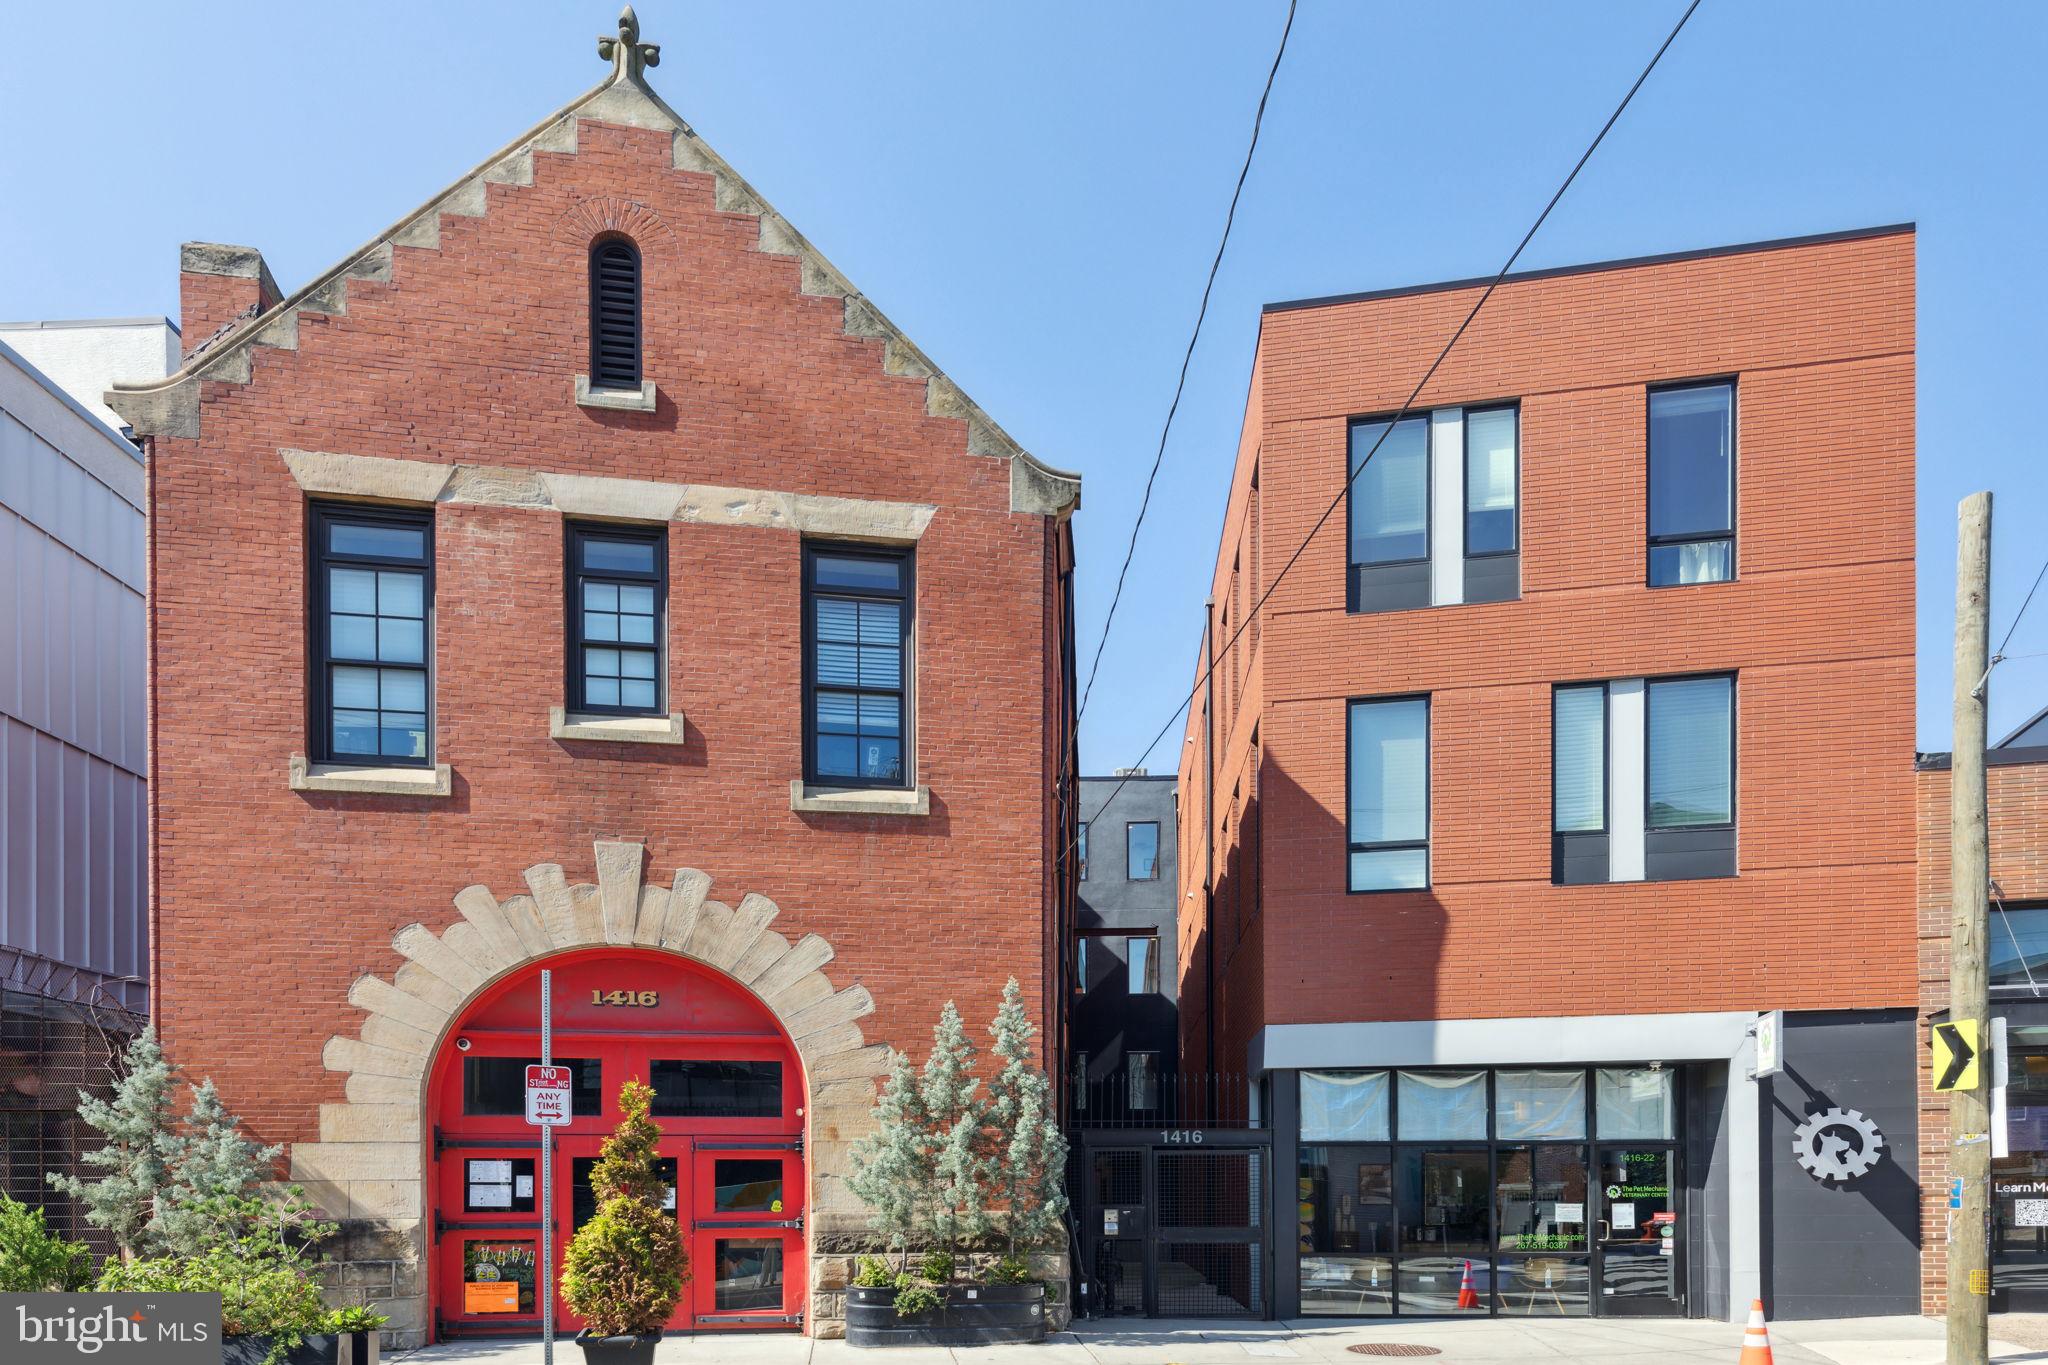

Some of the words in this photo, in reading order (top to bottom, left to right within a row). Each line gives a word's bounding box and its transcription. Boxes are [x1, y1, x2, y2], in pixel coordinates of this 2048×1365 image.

[591, 989, 658, 1007] 1416
[541, 1067, 557, 1079] NO
[529, 1078, 569, 1088] STNG
[536, 1092, 561, 1100] ANY
[536, 1101, 562, 1110] TIME
[1160, 1130, 1203, 1143] 1416
[1620, 1153, 1655, 1162] 1416-22
[1995, 1182, 2031, 1193] Learn
[1516, 1241, 1568, 1249] 267-519-0387
